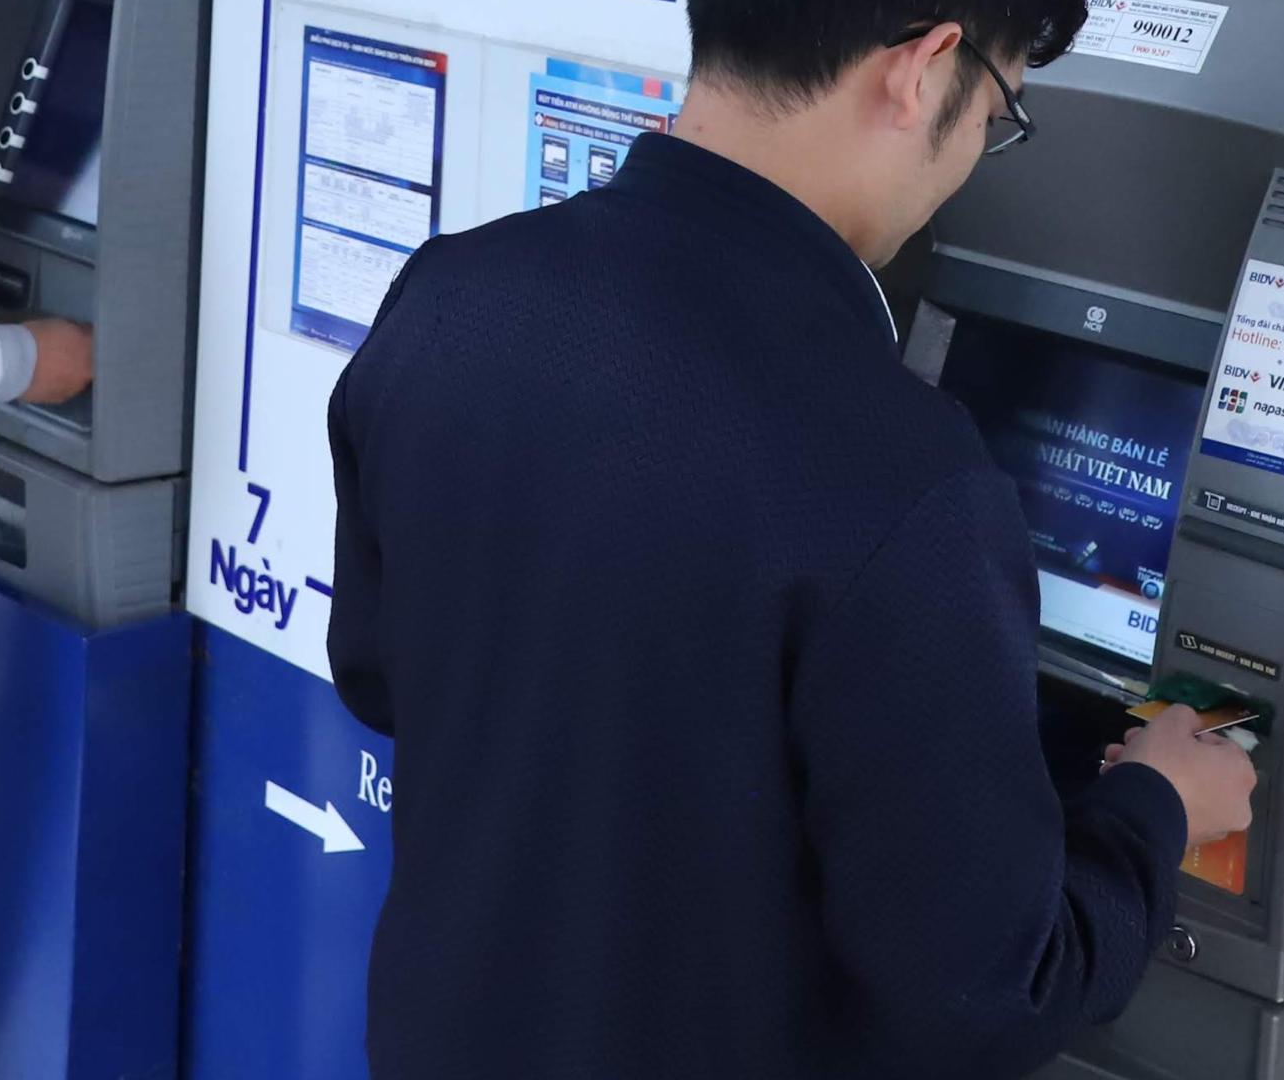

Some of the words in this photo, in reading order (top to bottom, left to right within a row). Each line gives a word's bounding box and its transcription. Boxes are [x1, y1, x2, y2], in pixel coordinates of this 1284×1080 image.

[1131, 19, 1193, 43] 990012
[1249, 271, 1275, 288] BIDV
[1231, 327, 1282, 350] Hotline:
[1223, 364, 1251, 380] BIDV
[1065, 424, 1109, 449] HÀNG
[1111, 438, 1146, 460] BÁN
[1147, 447, 1170, 468] LẺ
[1087, 457, 1127, 486] VIỆT
[1127, 470, 1173, 500] NAM
[247, 482, 271, 544] 7
[210, 538, 298, 630] Ngày
[1128, 610, 1158, 634] BID
[357, 750, 393, 812] Re
